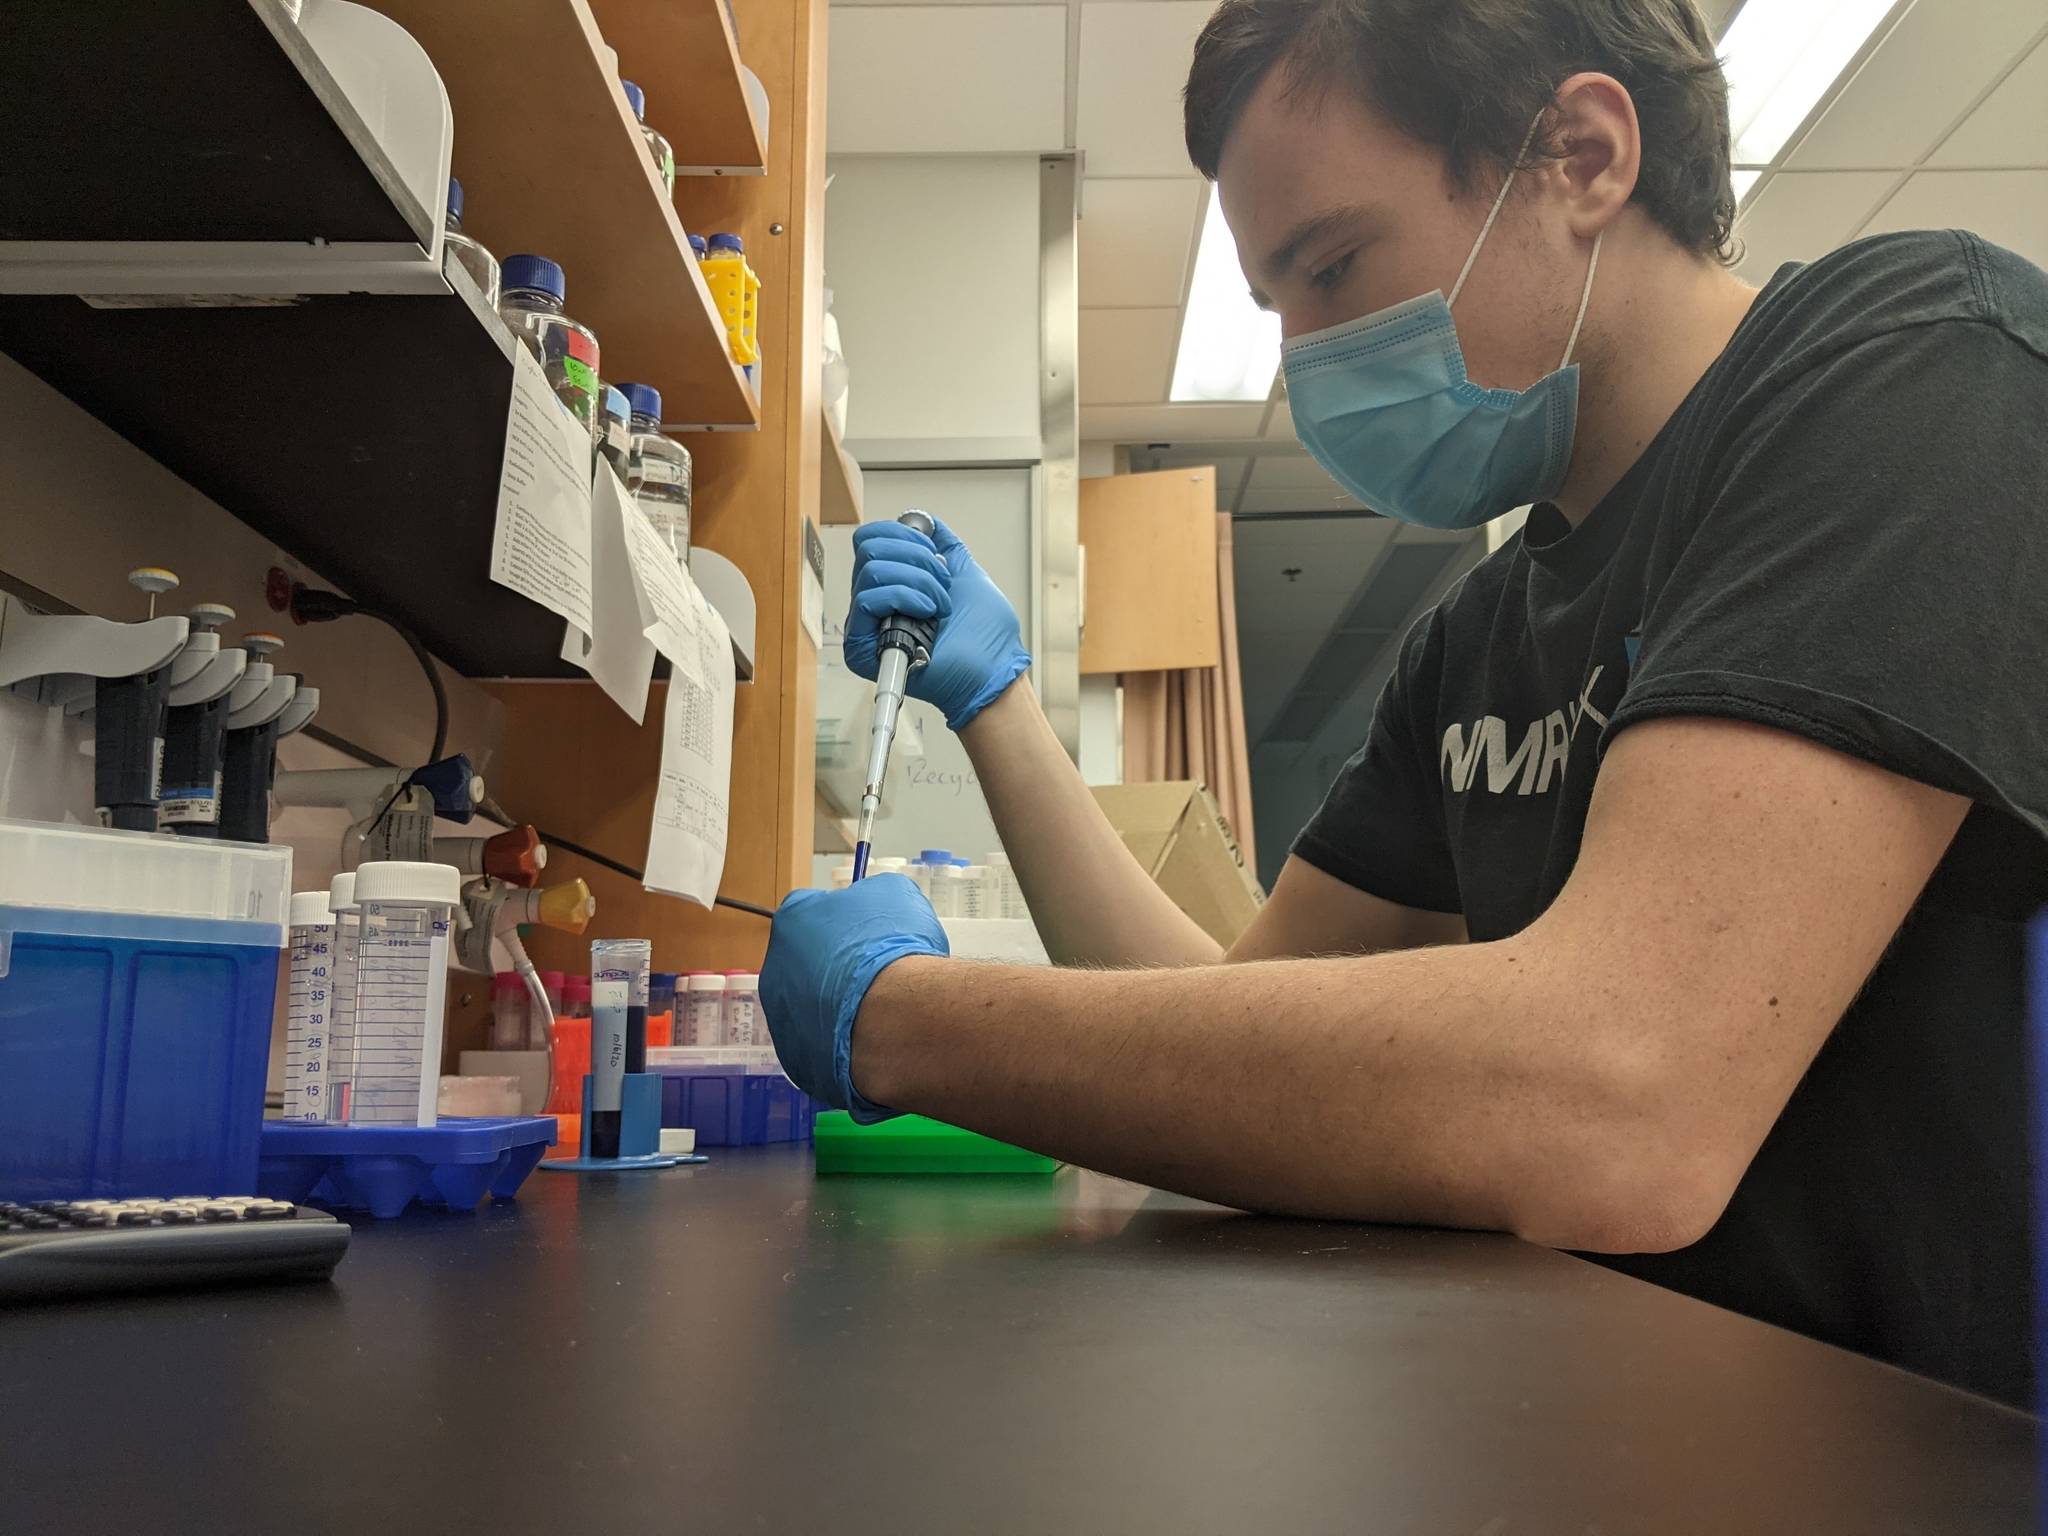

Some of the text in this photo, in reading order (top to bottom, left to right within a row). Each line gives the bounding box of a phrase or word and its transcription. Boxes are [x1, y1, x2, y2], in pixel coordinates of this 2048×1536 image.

[1440, 665, 1608, 795] NMAK
[312, 943, 328, 954] 45
[311, 967, 326, 977] 40
[310, 990, 325, 1001] 35
[309, 1014, 323, 1024] 30
[307, 1038, 322, 1048] 25
[306, 1061, 320, 1072] 20
[305, 1085, 319, 1096] 15
[303, 1112, 317, 1120] 10
